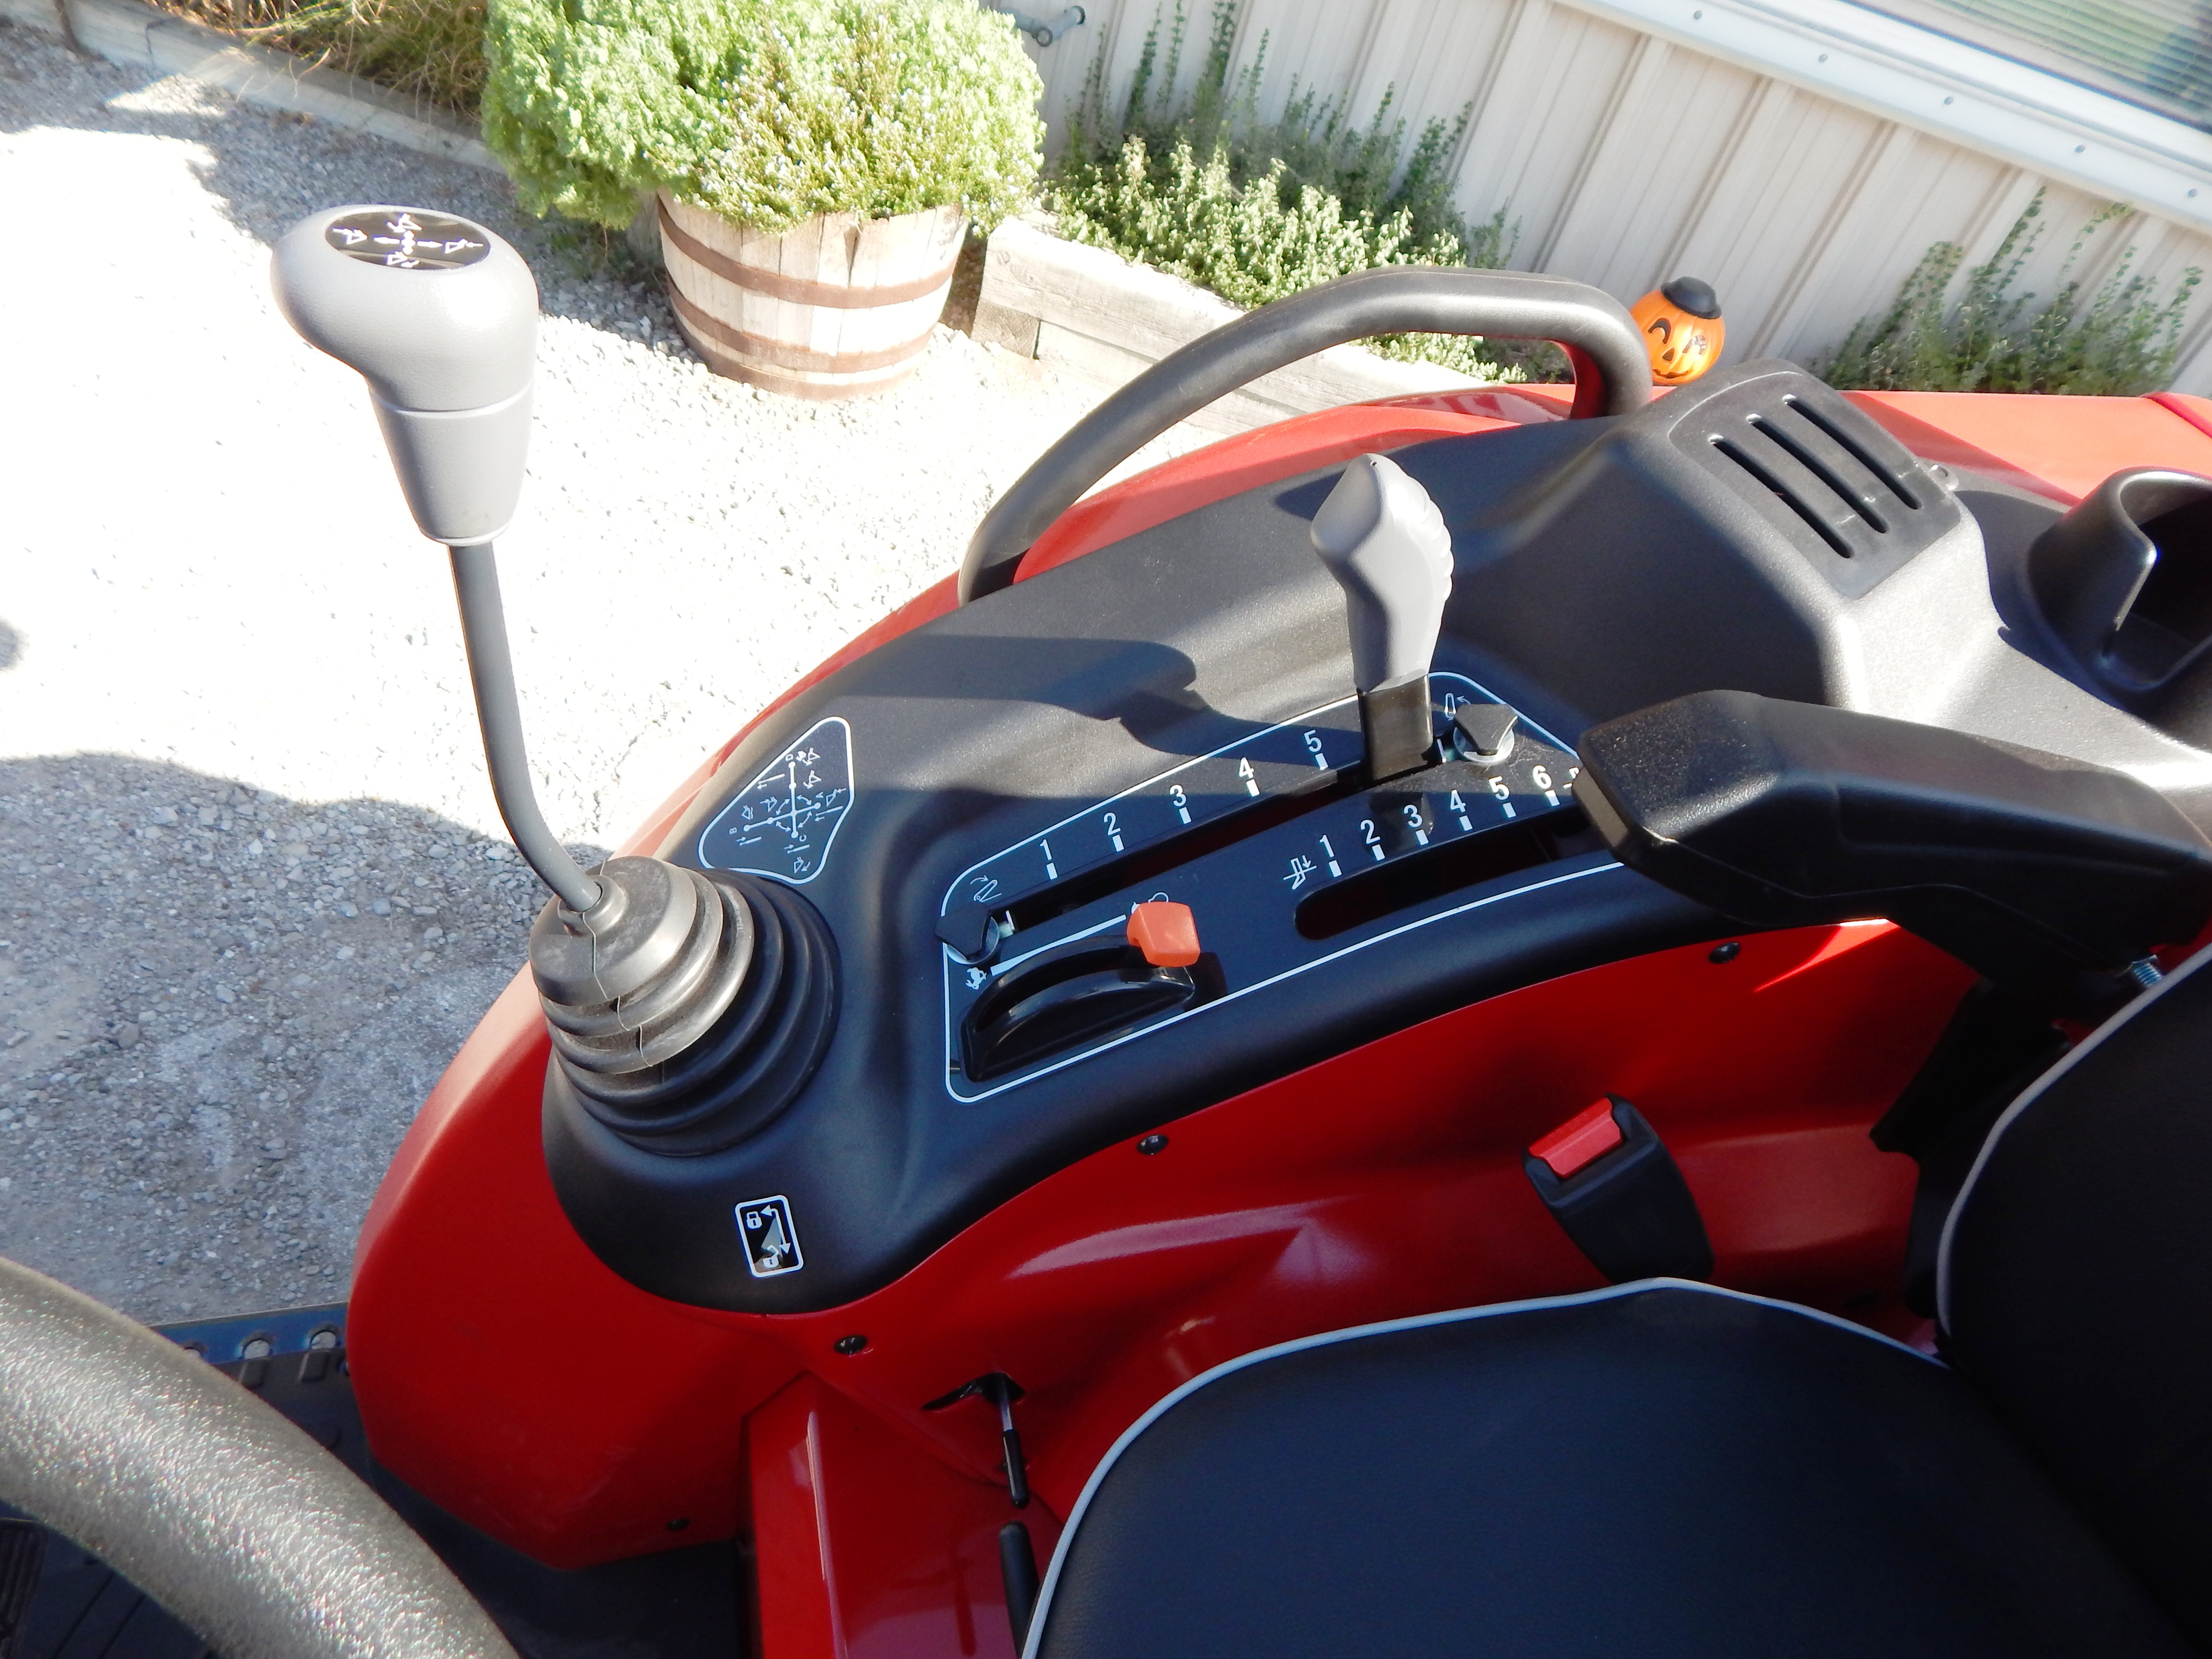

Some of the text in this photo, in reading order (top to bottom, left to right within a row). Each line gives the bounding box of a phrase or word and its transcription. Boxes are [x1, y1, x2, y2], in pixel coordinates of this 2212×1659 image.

[1040, 729, 1322, 861] 1 2 3 4 5
[1319, 765, 1552, 857] 1 2 3 4 5 6
